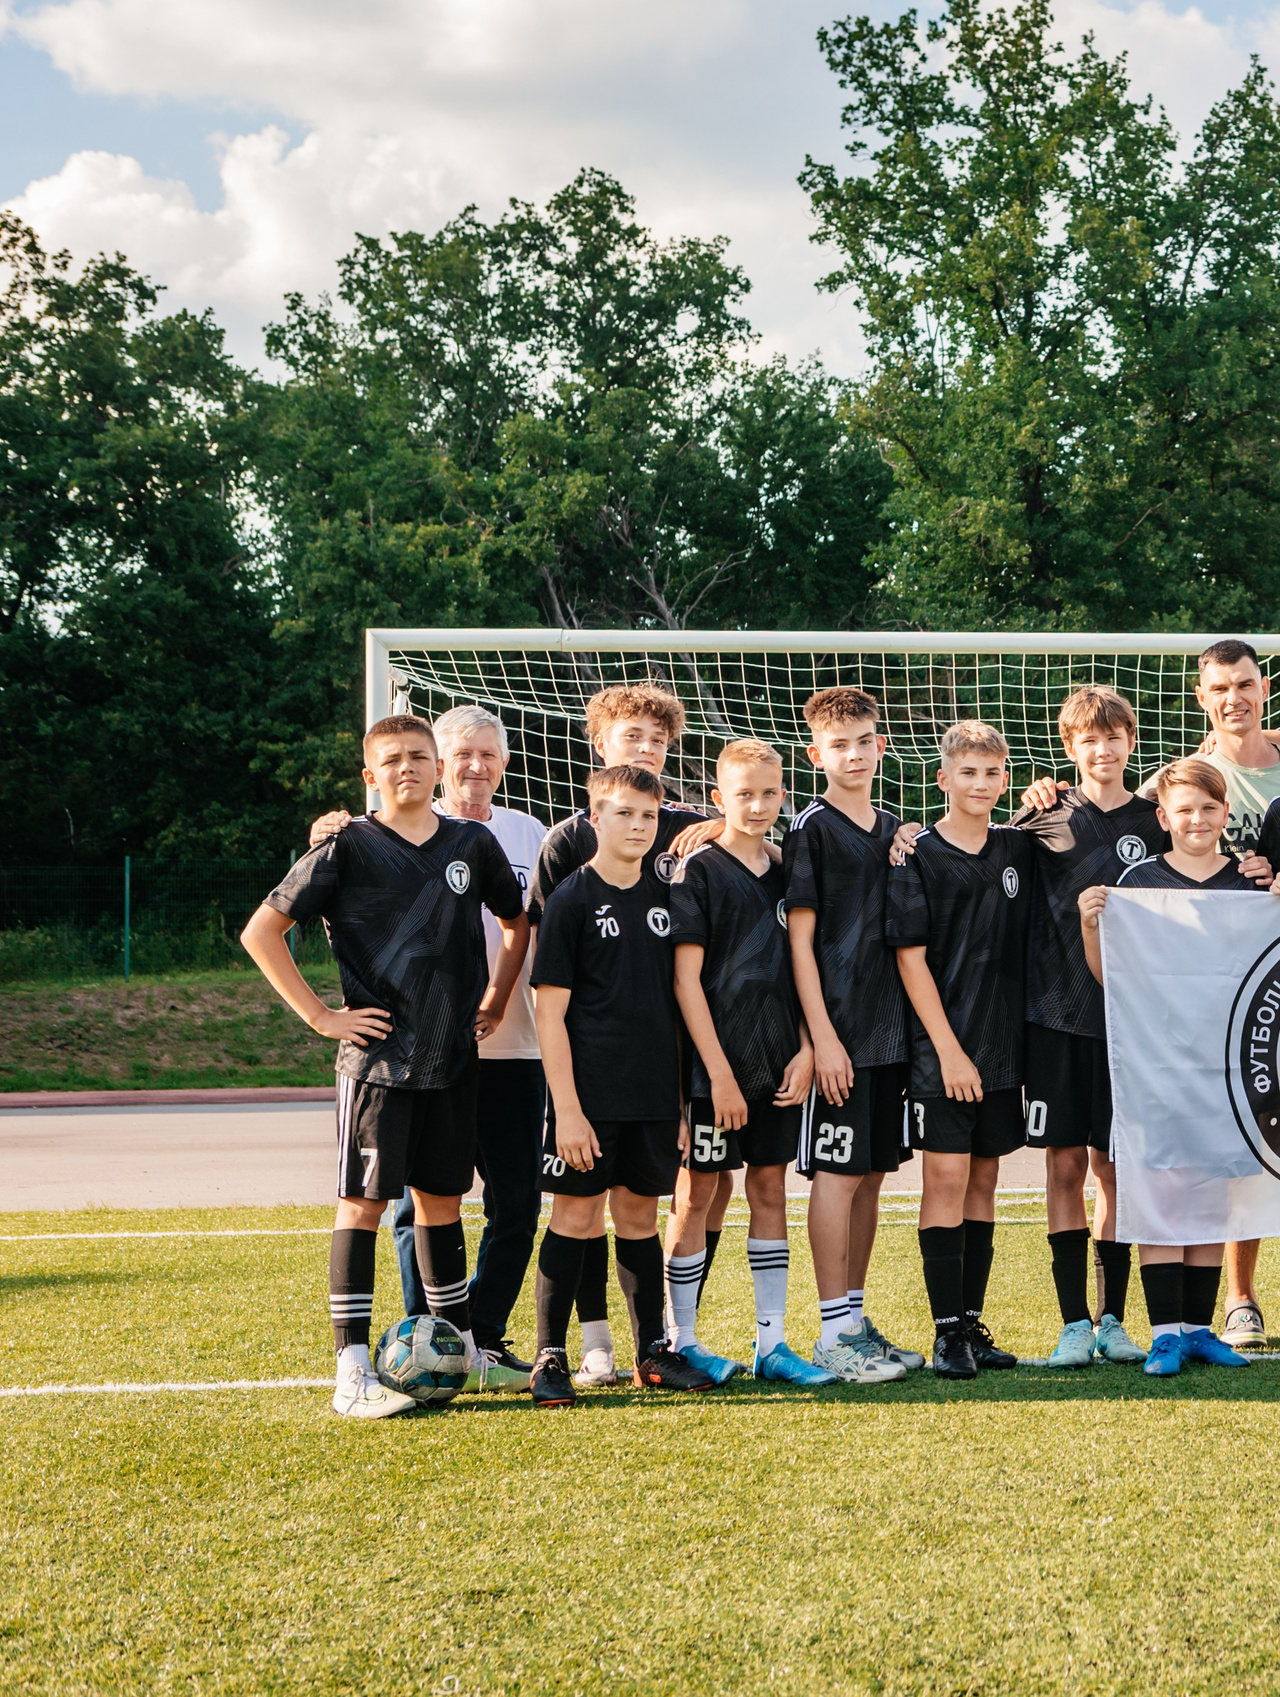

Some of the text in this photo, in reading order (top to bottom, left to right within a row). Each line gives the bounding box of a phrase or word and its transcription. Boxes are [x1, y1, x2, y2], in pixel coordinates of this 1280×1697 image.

[1224, 845, 1245, 853] Klein
[596, 917, 620, 938] 70
[1026, 1100, 1048, 1137] 0
[694, 1124, 727, 1162] 55
[815, 1122, 854, 1164] 23
[360, 1148, 379, 1188] 7
[543, 1153, 566, 1177] 70
